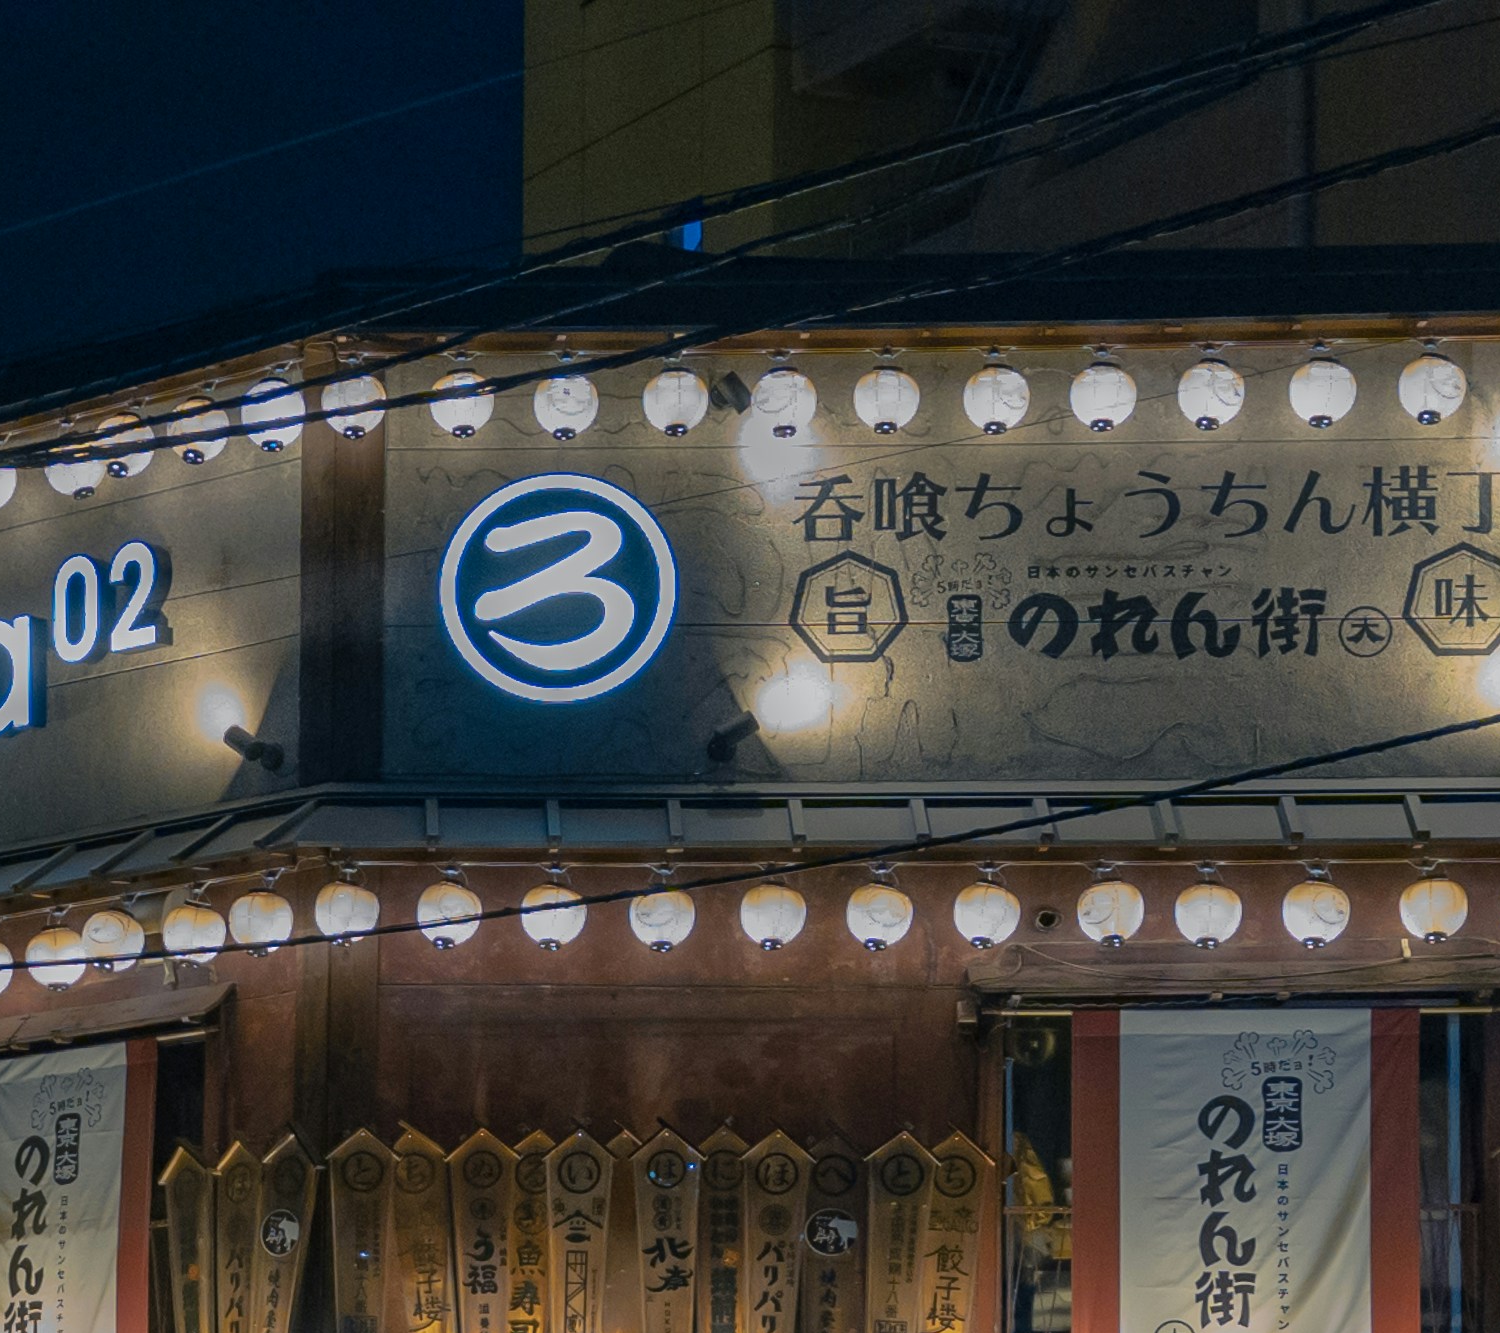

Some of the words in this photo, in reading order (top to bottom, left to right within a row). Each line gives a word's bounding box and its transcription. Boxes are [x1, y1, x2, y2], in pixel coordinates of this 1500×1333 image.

[53, 541, 162, 663] 02
[1027, 563, 1232, 580] 日本のサンセバスチャン
[1434, 575, 1493, 628] 味
[826, 586, 871, 636] 旨
[1008, 588, 1324, 659] のれん街
[1265, 1081, 1300, 1147] 東京大塚
[56, 1118, 78, 1180] 東京大塚
[1195, 1095, 1256, 1329] のれん街
[1276, 1163, 1290, 1330] 日本のサンセバスチャン
